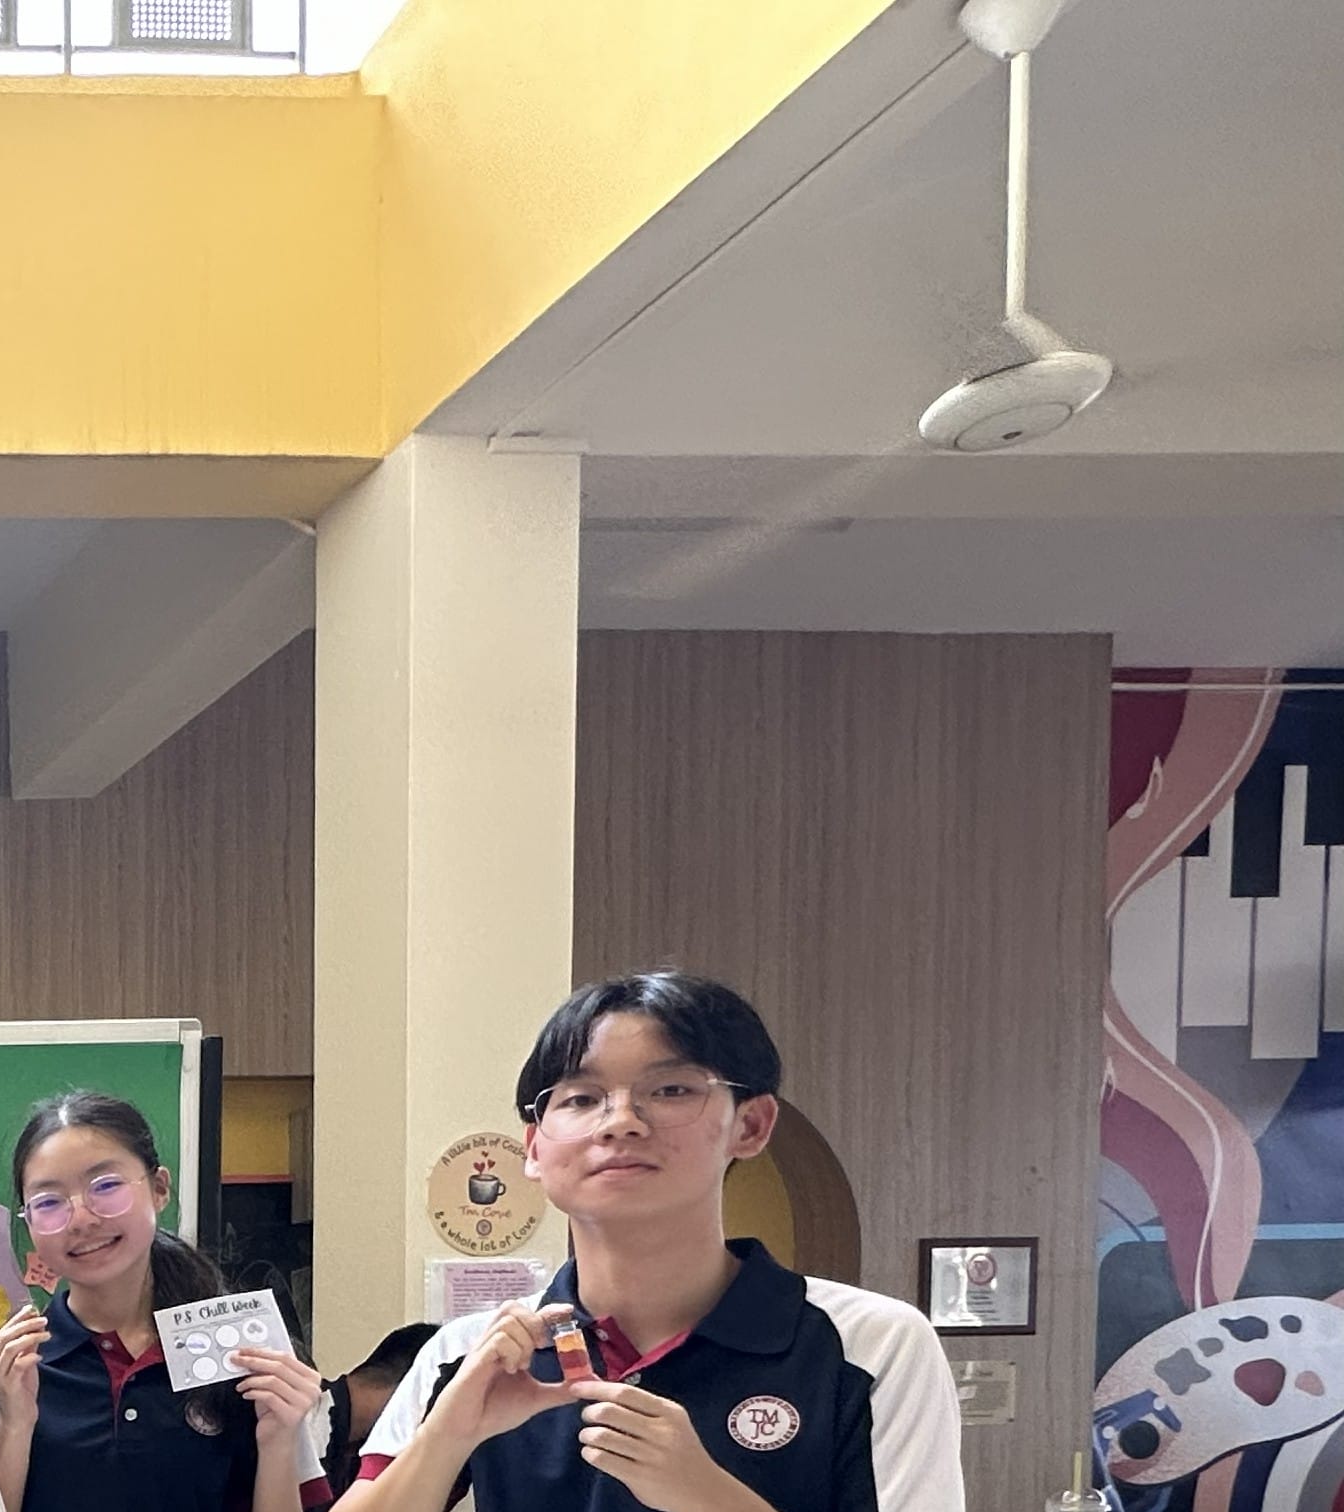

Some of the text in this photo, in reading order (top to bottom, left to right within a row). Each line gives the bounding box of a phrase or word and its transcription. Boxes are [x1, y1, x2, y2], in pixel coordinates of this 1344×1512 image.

[472, 1137, 488, 1148] bit
[488, 1138, 501, 1148] of
[447, 1228, 478, 1252] whole
[479, 1240, 498, 1252] lot
[499, 1235, 512, 1249] of
[198, 1300, 229, 1320] Chill
[231, 1297, 263, 1315] Week
